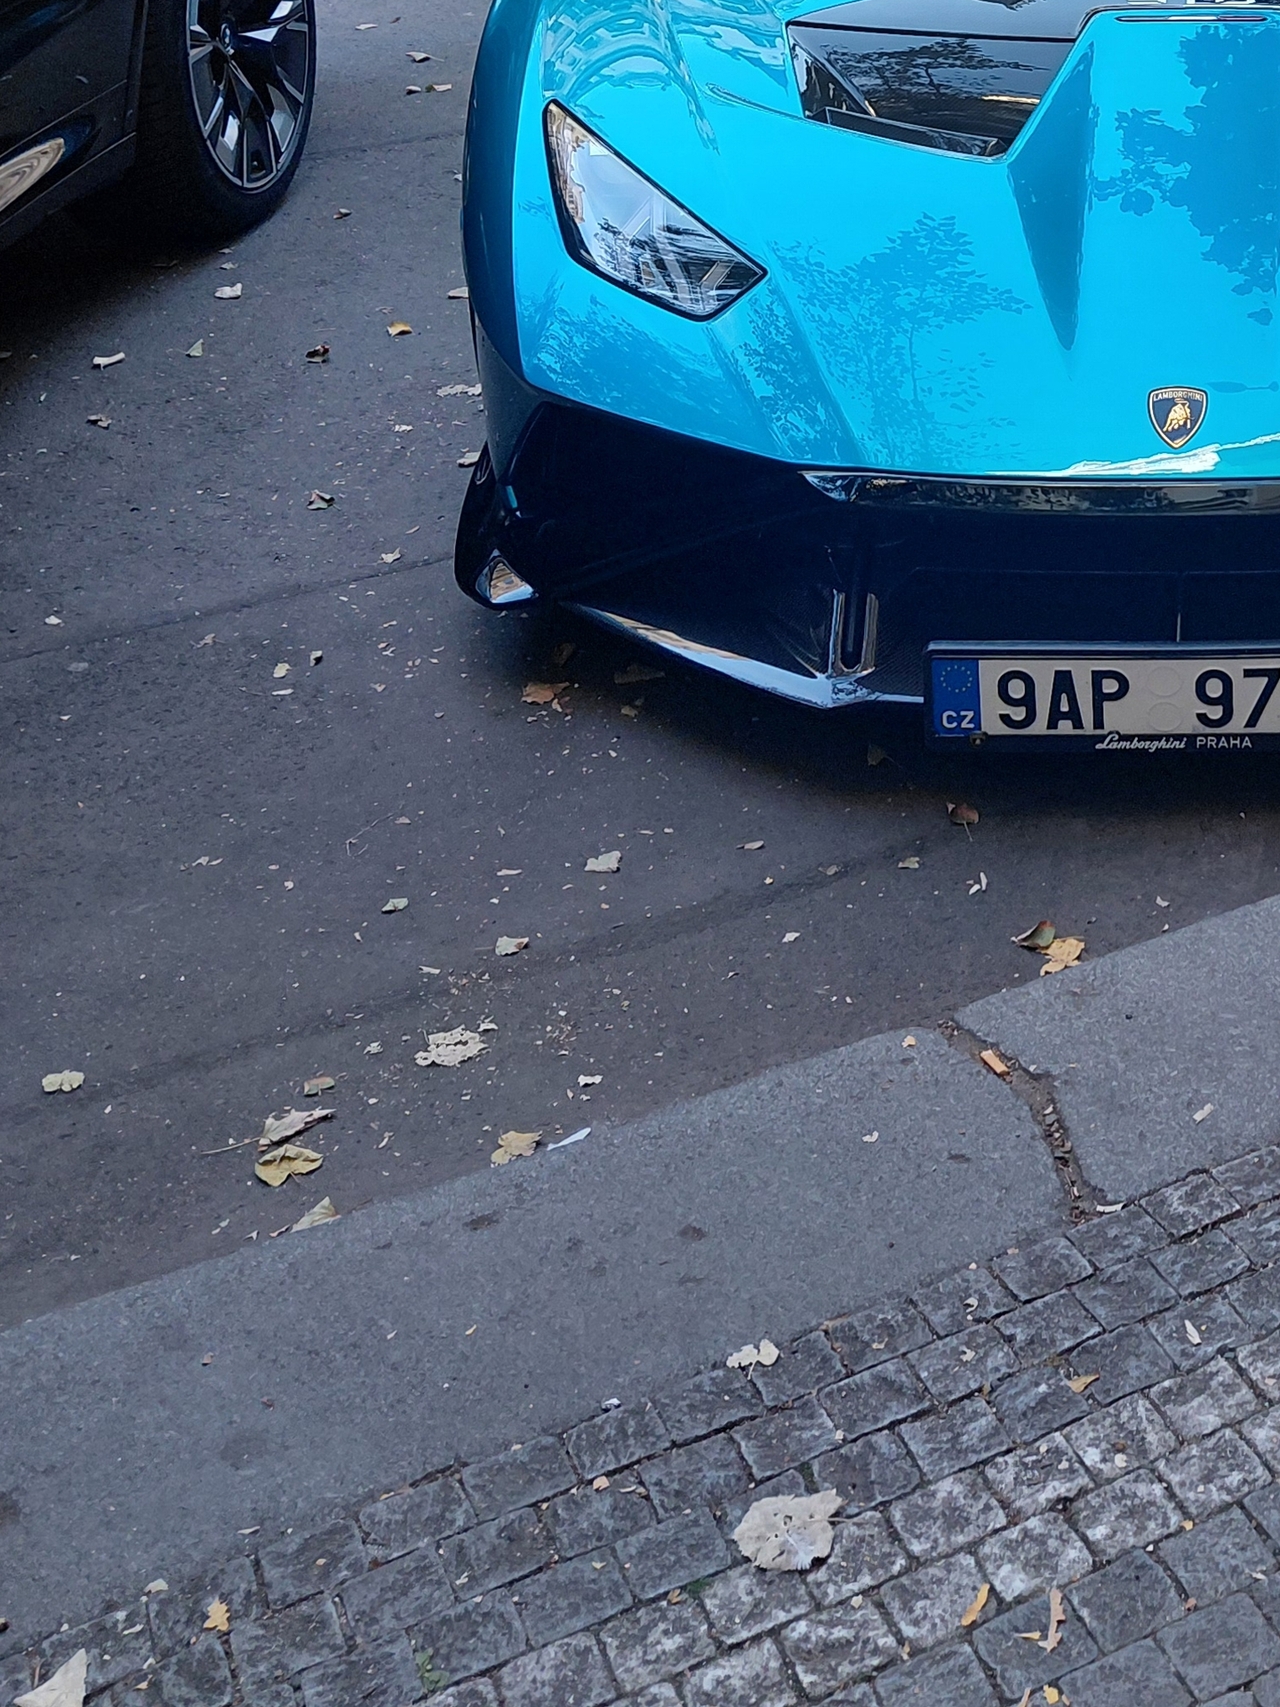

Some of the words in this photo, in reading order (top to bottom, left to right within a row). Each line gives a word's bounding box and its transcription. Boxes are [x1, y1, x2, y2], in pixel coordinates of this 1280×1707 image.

[1153, 391, 1203, 402] LAMBORGHINI
[941, 710, 975, 730] CZ
[996, 668, 1130, 731] 9AP
[1095, 733, 1188, 753] Lamborghini
[1196, 736, 1253, 749] PRAHA
